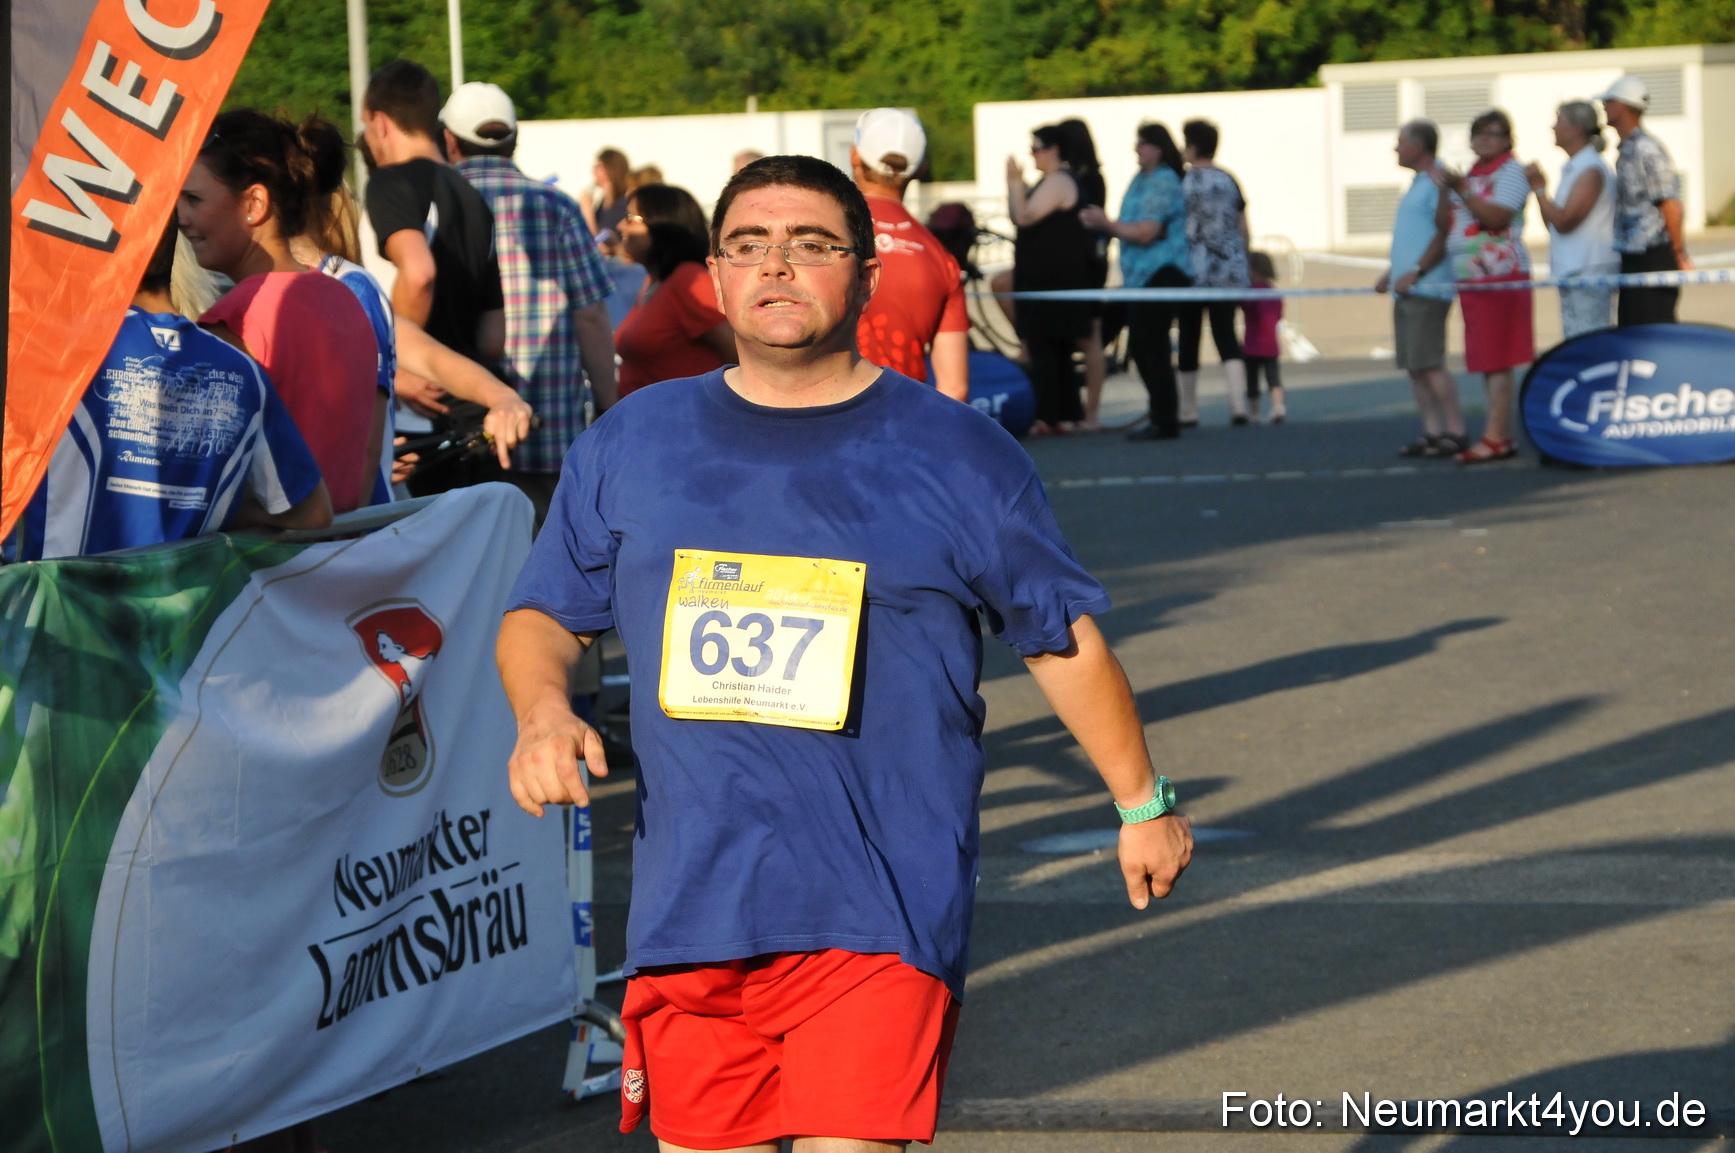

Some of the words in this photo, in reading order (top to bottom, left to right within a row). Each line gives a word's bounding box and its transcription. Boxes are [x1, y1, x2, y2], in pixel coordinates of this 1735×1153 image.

[180, 405, 200, 415] Dich
[698, 577, 765, 593] firmenlauf
[678, 595, 729, 609] walken
[689, 609, 825, 681] 637
[712, 680, 756, 692] Christian
[757, 683, 792, 695] Haider
[692, 695, 742, 705] Lebenshilfe
[743, 697, 789, 710] Neumarkt
[790, 701, 808, 712] e.V.
[384, 743, 418, 777] 1628
[333, 808, 491, 918] Neumarkter
[307, 868, 529, 1031] Lammsbräu
